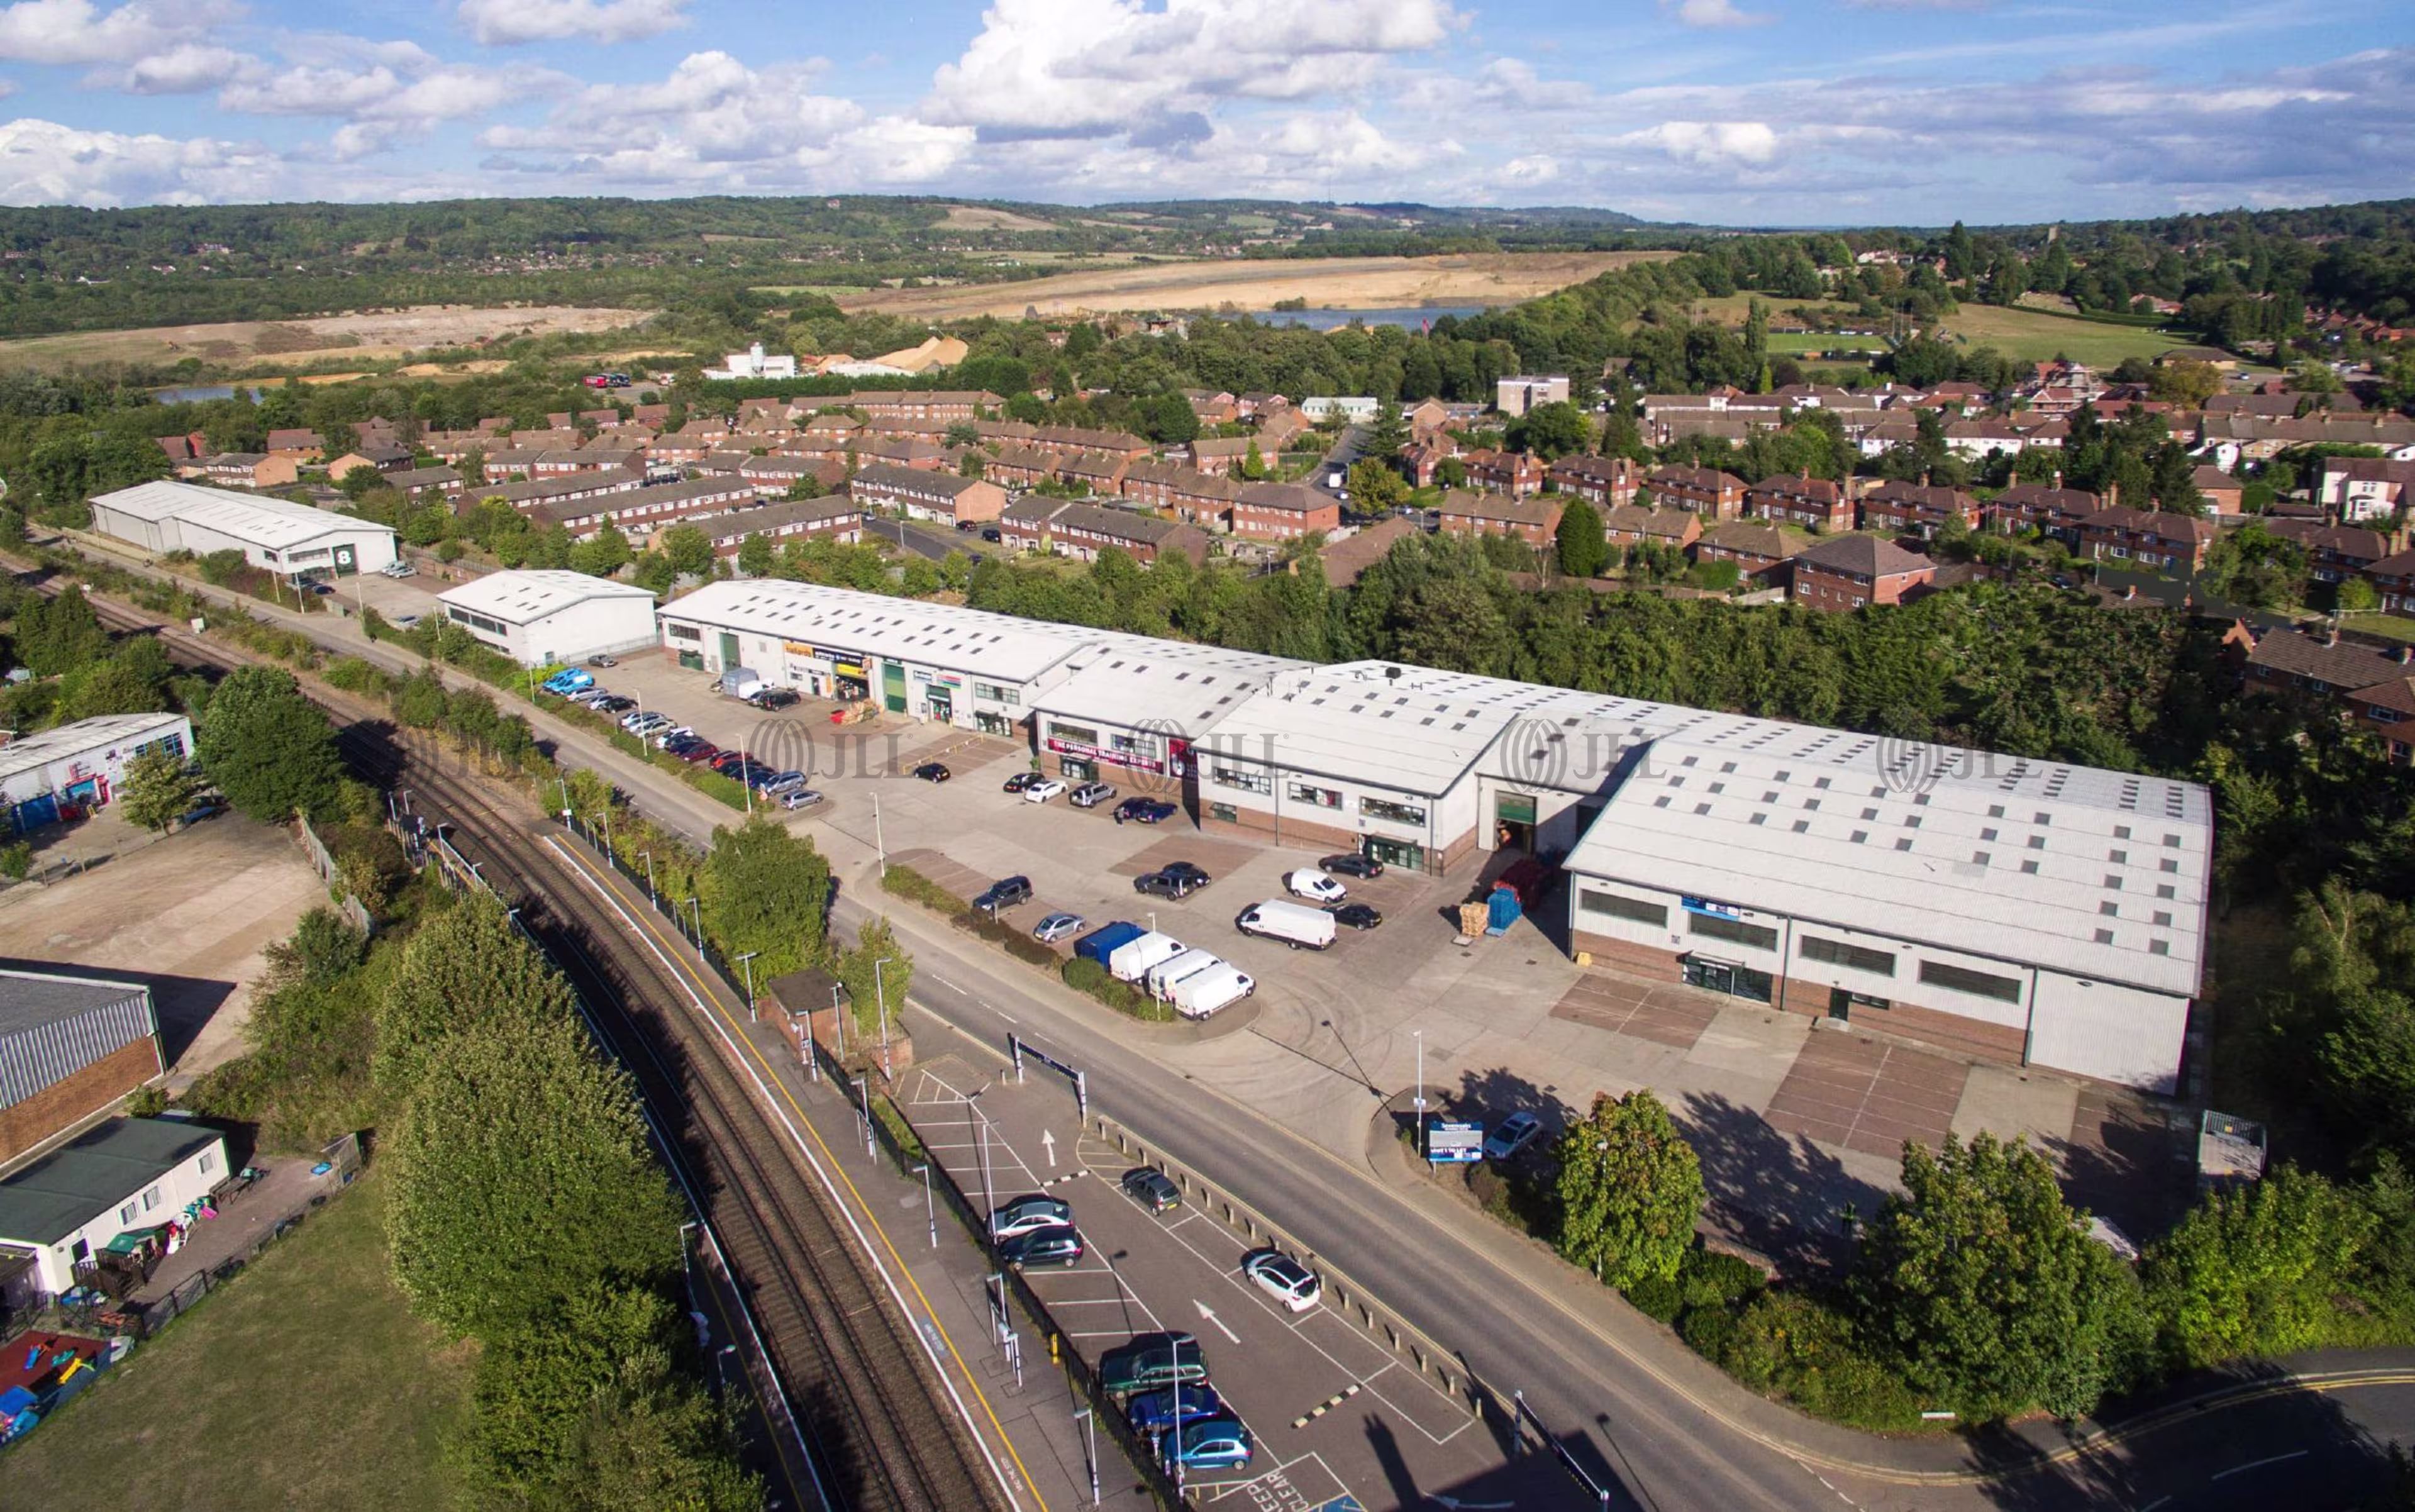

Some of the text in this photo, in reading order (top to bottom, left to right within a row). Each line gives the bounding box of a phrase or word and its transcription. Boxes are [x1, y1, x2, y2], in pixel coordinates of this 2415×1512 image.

[337, 550, 352, 565] 8
[1247, 1484, 1284, 1512] EEP
[1267, 1470, 1309, 1512] CLEAR
